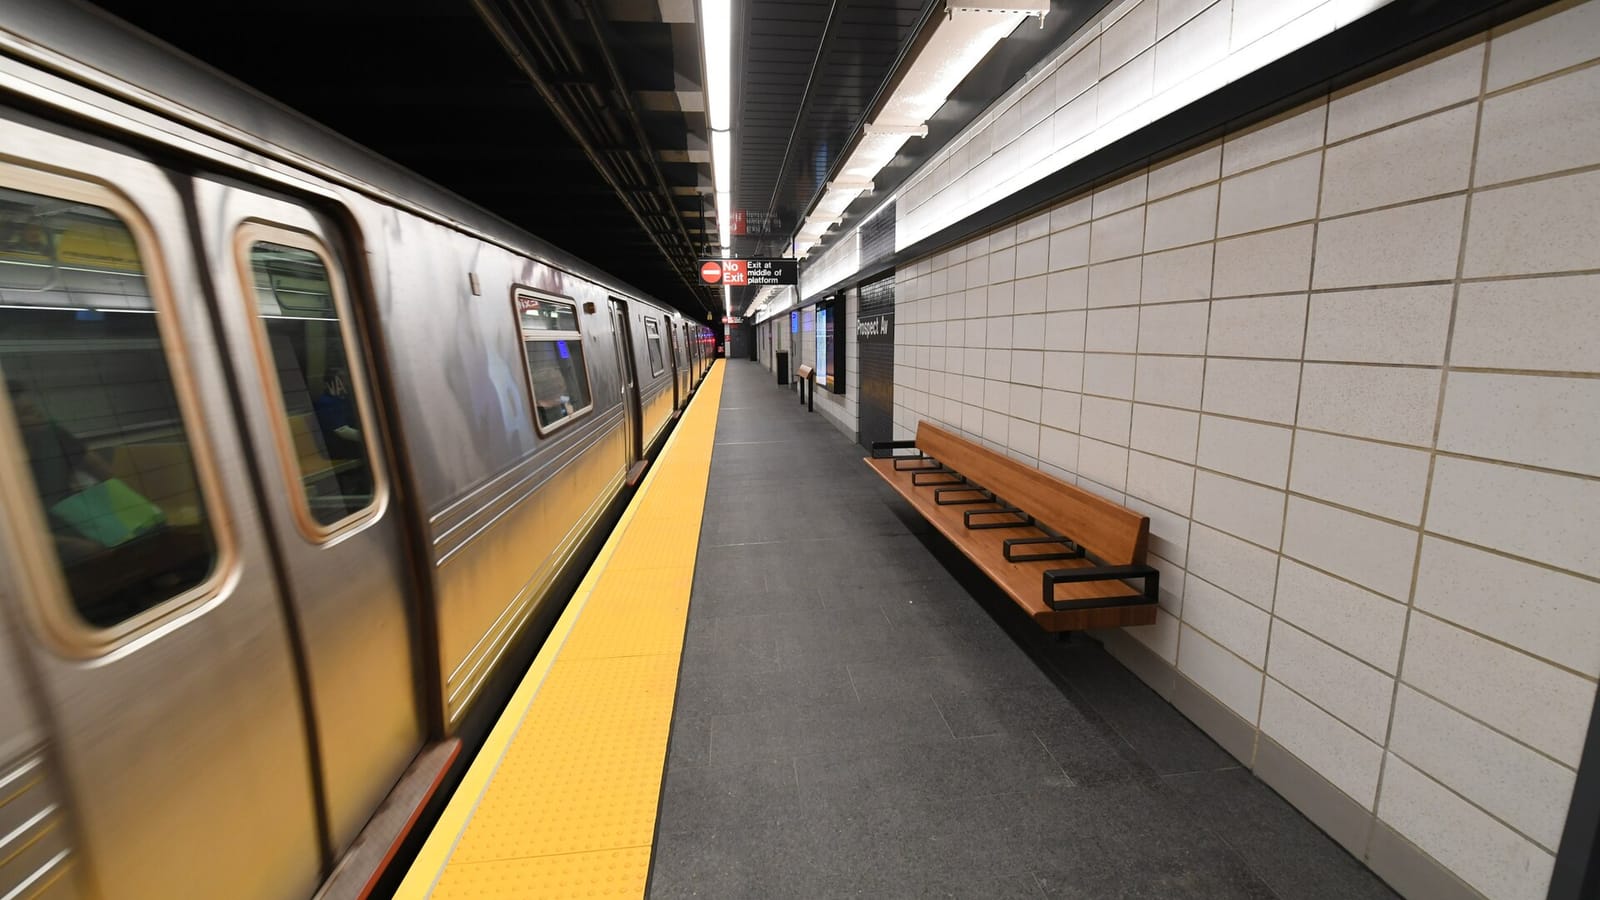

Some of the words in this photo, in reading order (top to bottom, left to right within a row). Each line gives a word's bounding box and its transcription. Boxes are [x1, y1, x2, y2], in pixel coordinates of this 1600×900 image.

[723, 262, 738, 271] No
[723, 273, 744, 282] Exit
[747, 277, 778, 285] platform
[857, 317, 878, 339] Prospect
[880, 316, 888, 334] Av
